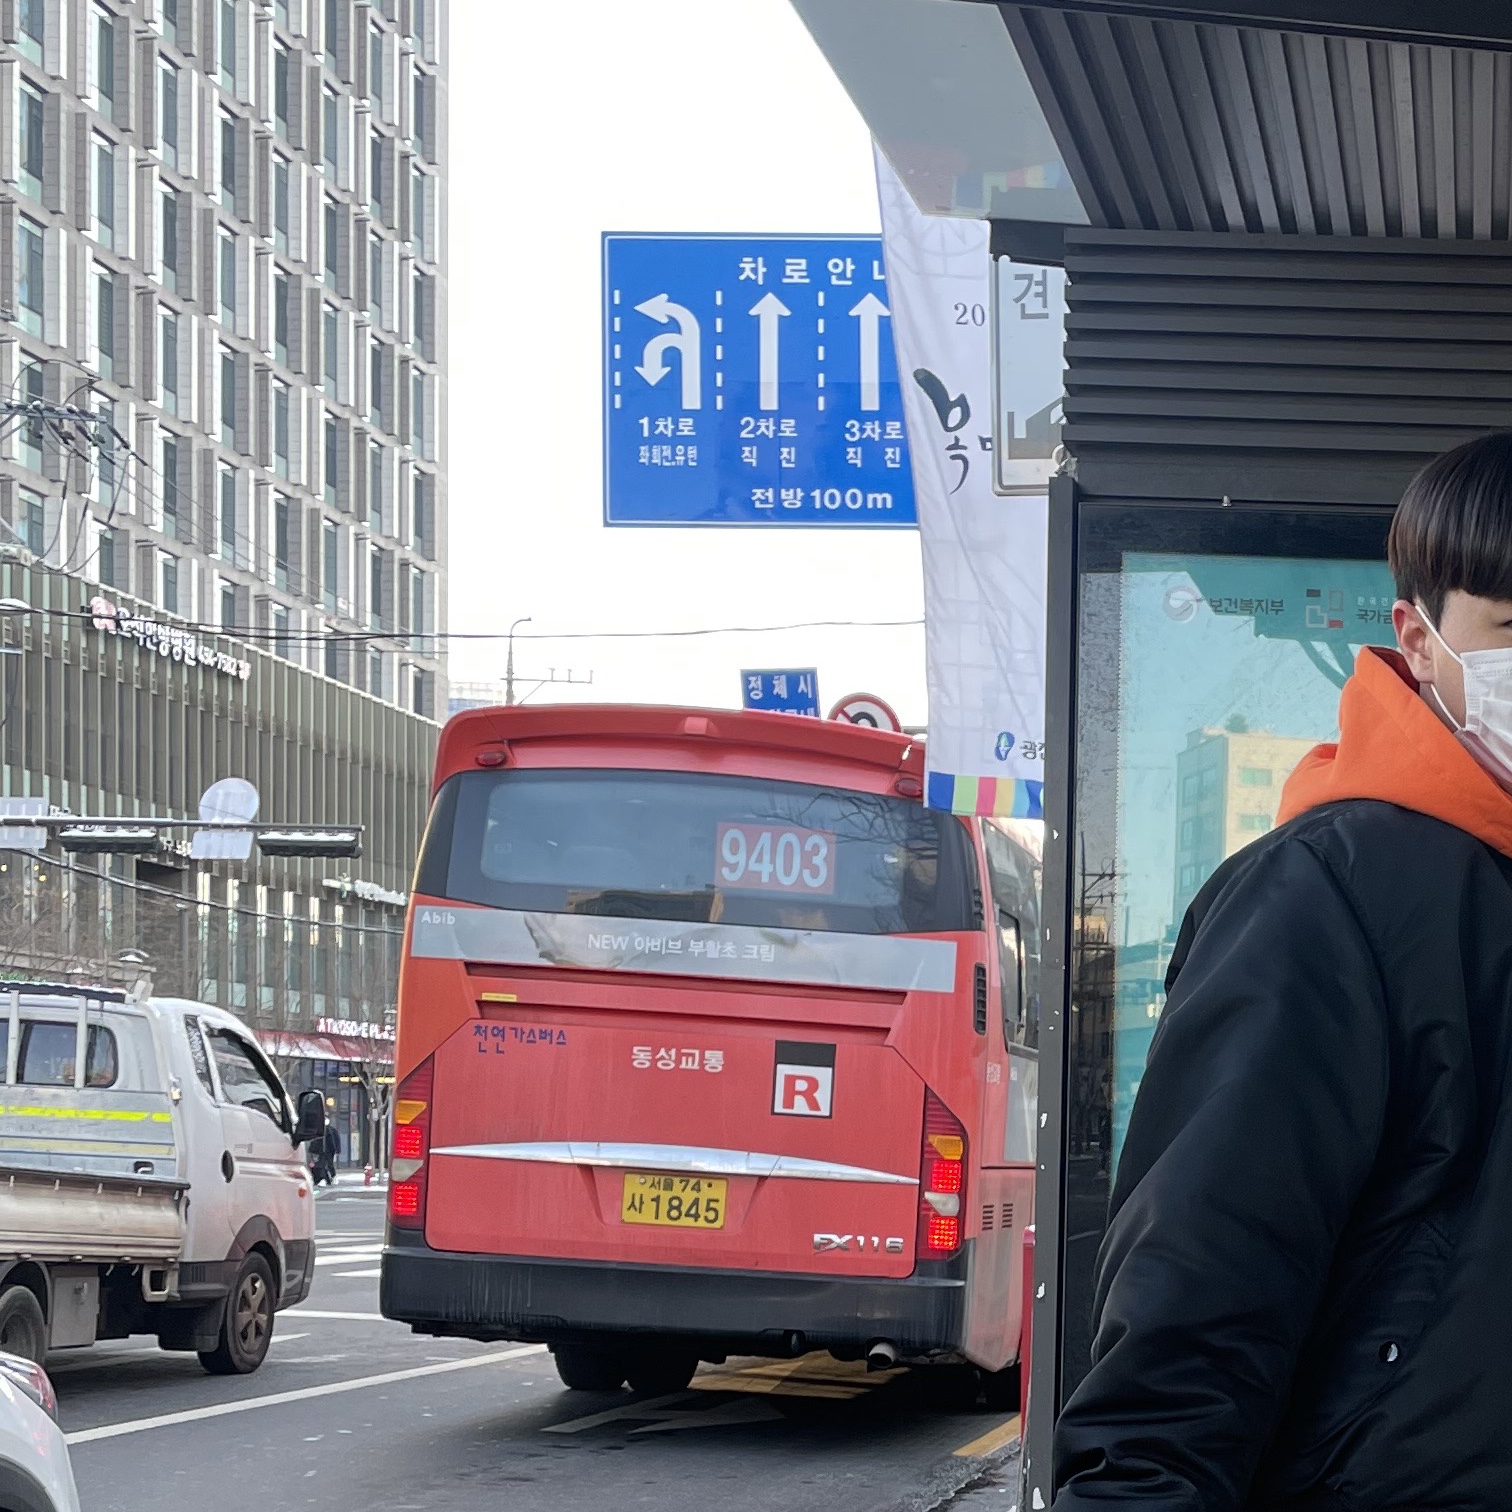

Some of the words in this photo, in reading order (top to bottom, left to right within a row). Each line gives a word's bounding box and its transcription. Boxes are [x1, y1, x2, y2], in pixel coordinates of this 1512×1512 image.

[638, 416, 697, 438] 1차로
[739, 416, 798, 439] 2차로
[844, 419, 904, 442] 3차로
[1208, 597, 1285, 616] 보건복지부
[720, 828, 830, 889] 9403
[420, 910, 456, 926] Abib
[587, 933, 629, 952] NEW
[634, 936, 684, 955] 아비브
[741, 943, 775, 963] 크림
[473, 1023, 568, 1054] 천연가스버스
[631, 1045, 725, 1072] 동성교통
[782, 1074, 820, 1111] R
[649, 1176, 674, 1192] 서울
[679, 1178, 702, 1193] 74
[626, 1193, 645, 1215] 사
[650, 1195, 720, 1225] 1845
[813, 1233, 904, 1255] FX116
